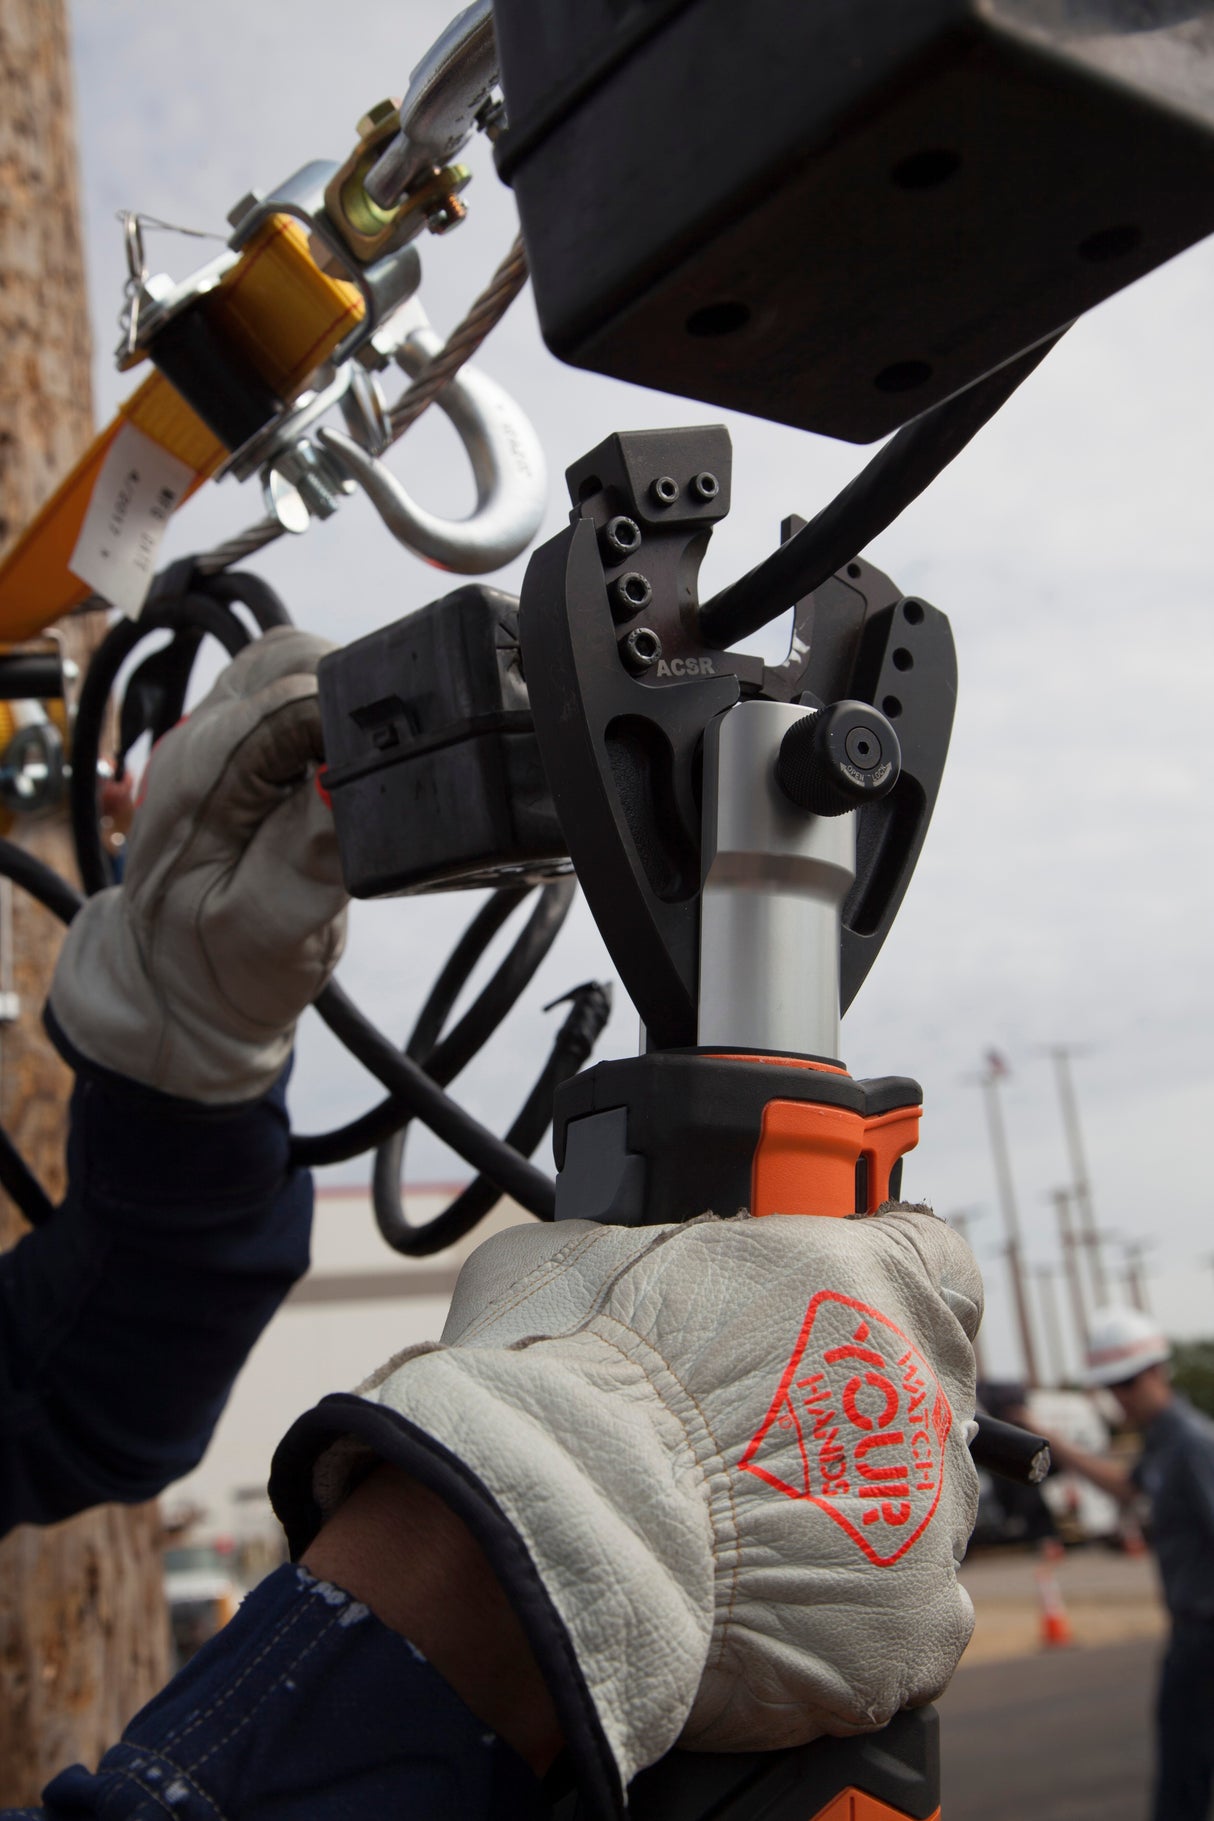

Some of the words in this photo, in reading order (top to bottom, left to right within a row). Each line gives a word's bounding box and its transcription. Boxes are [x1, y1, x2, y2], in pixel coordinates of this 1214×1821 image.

[656, 657, 716, 677] ACSR
[846, 764, 865, 781] OPEN
[872, 763, 887, 781] LOCK
[796, 1372, 851, 1496] HANDS
[823, 1320, 911, 1527] YOUR
[897, 1350, 935, 1491] WATCH
